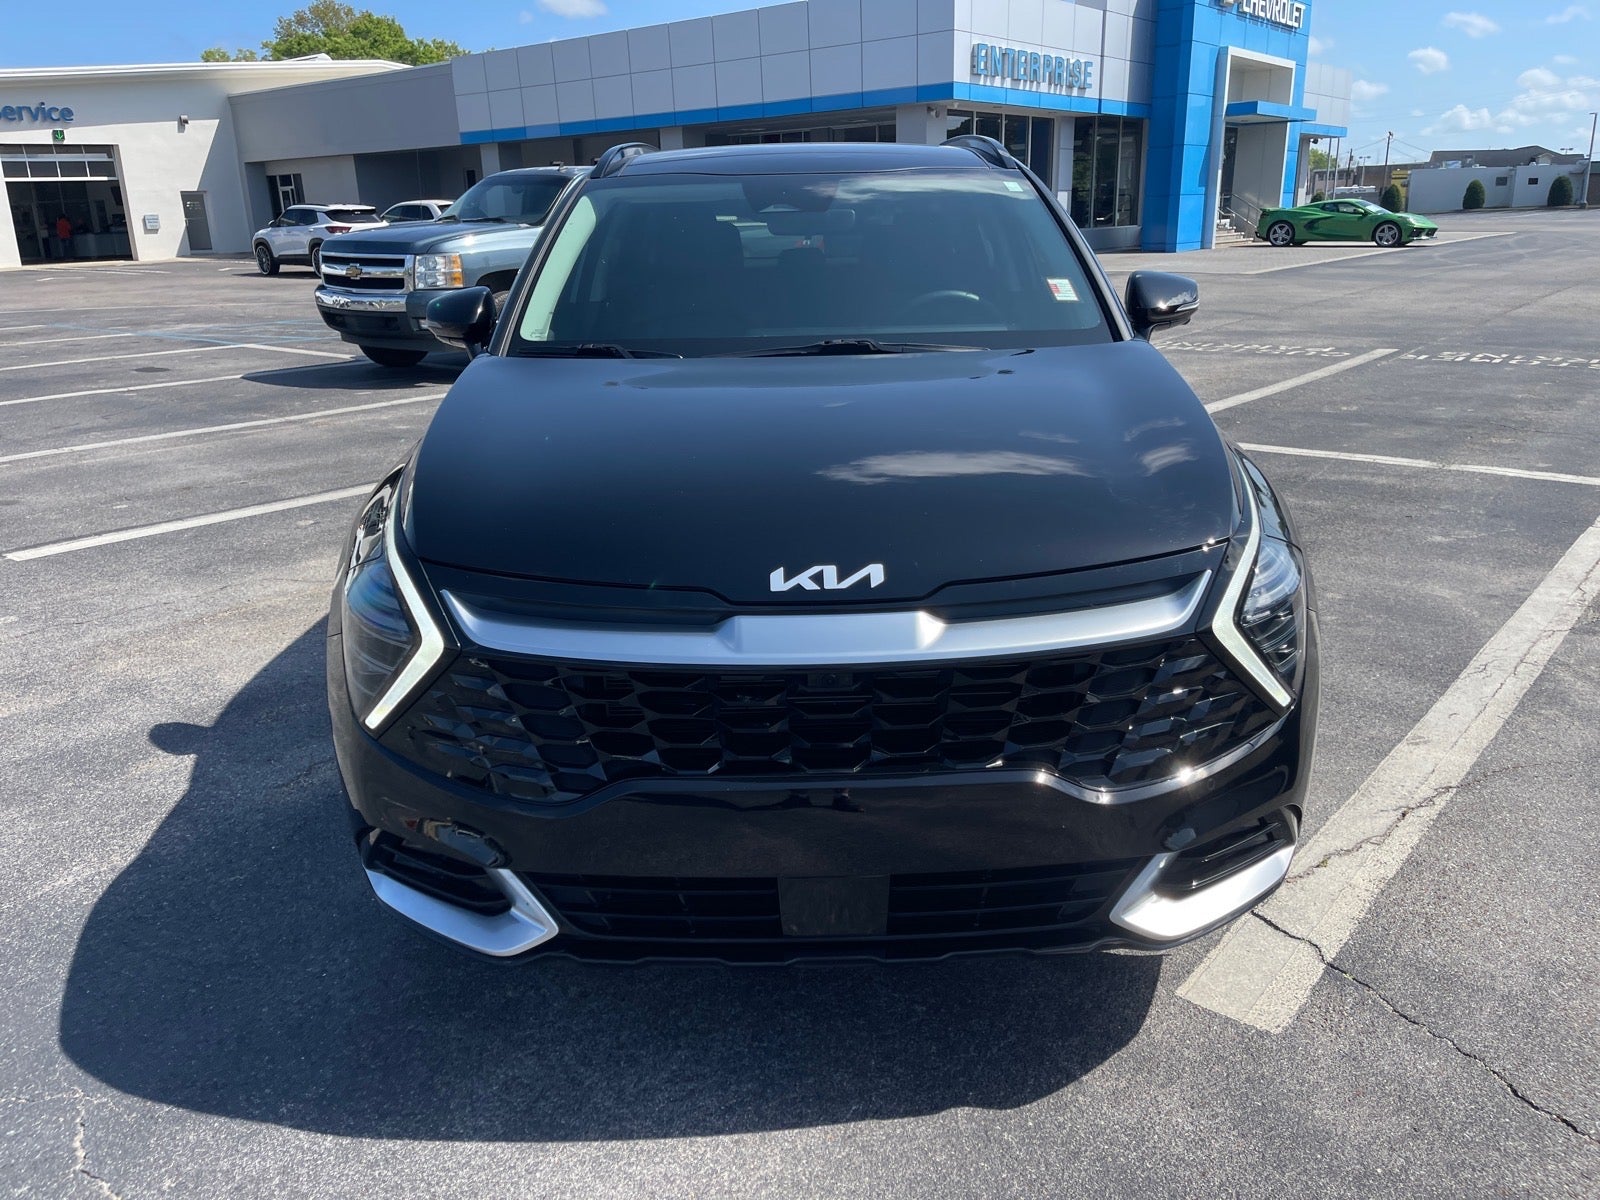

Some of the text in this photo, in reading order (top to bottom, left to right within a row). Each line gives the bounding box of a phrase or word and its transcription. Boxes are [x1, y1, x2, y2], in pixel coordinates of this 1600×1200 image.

[973, 43, 1093, 89] ENTERPRISE
[0, 102, 74, 122] ervice
[770, 564, 885, 592] KIA
